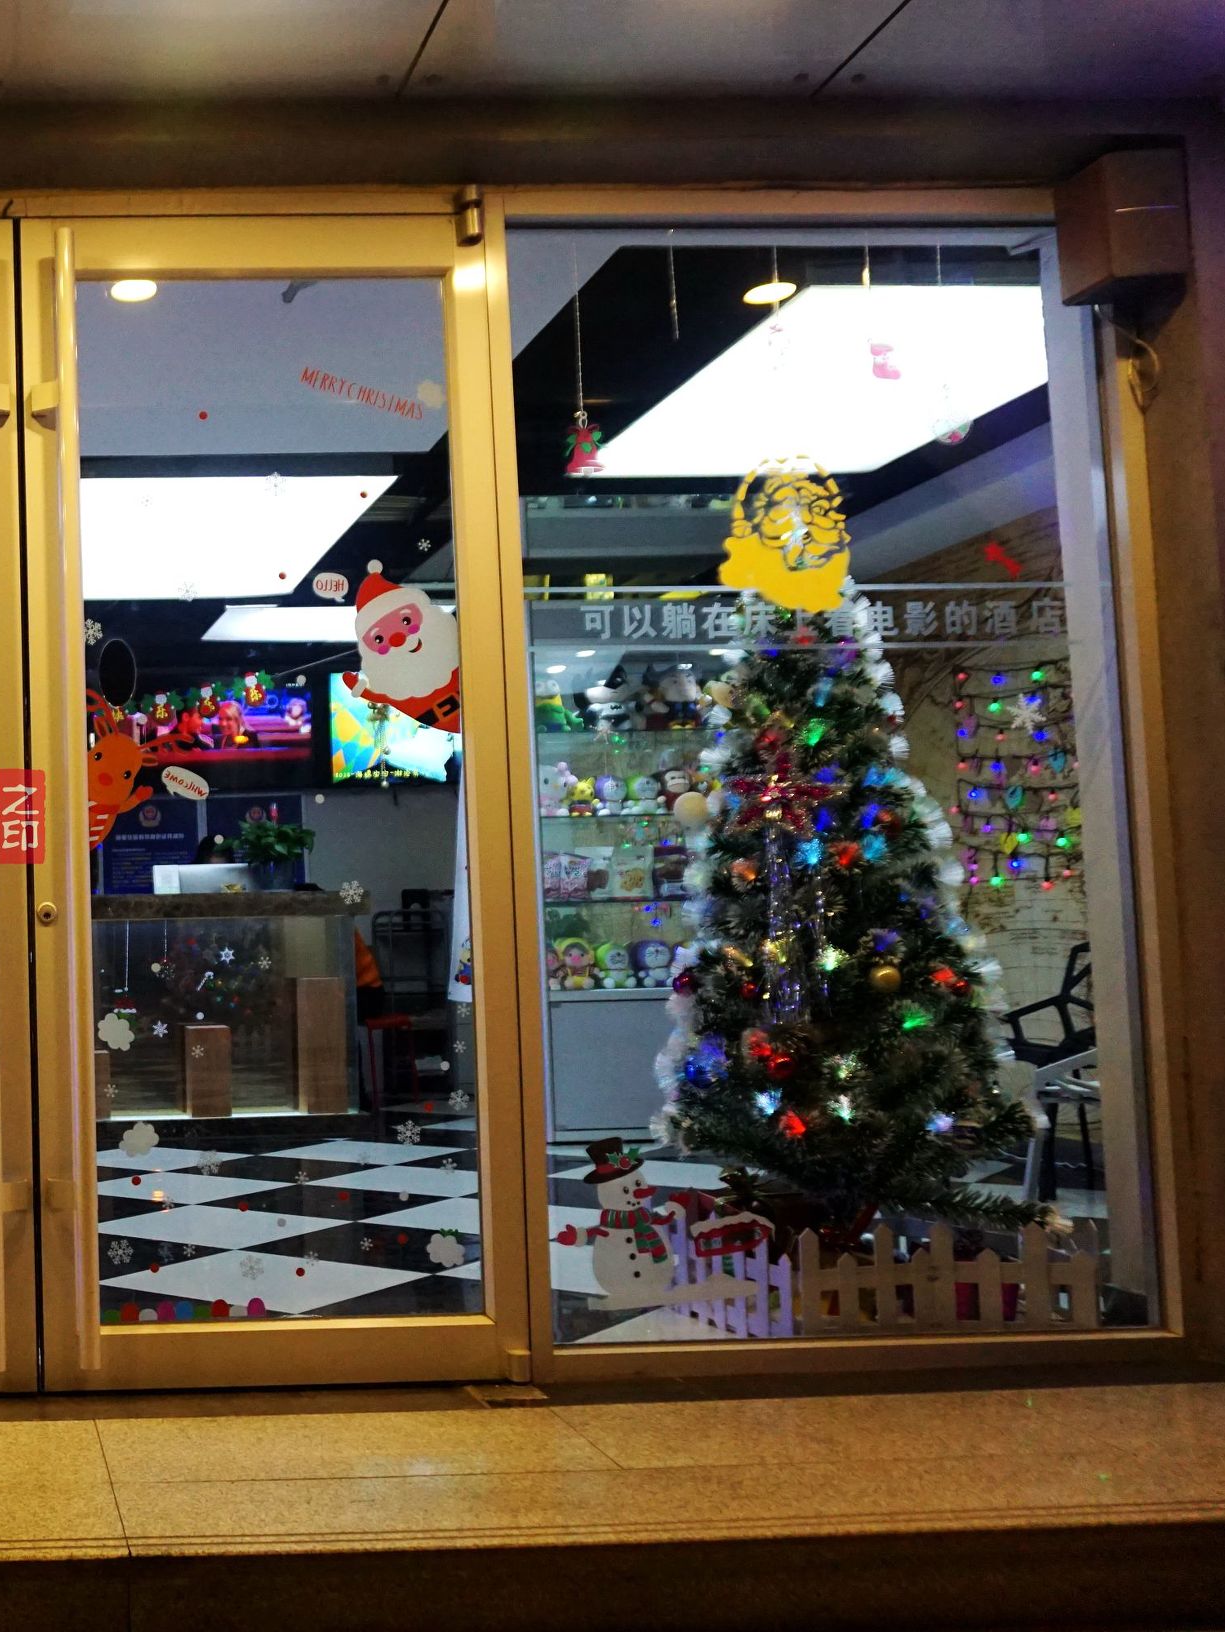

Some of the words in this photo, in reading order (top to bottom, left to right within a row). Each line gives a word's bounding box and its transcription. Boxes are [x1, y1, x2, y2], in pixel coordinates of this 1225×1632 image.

[579, 598, 1064, 640] 可以躺在床上看电影的酒店
